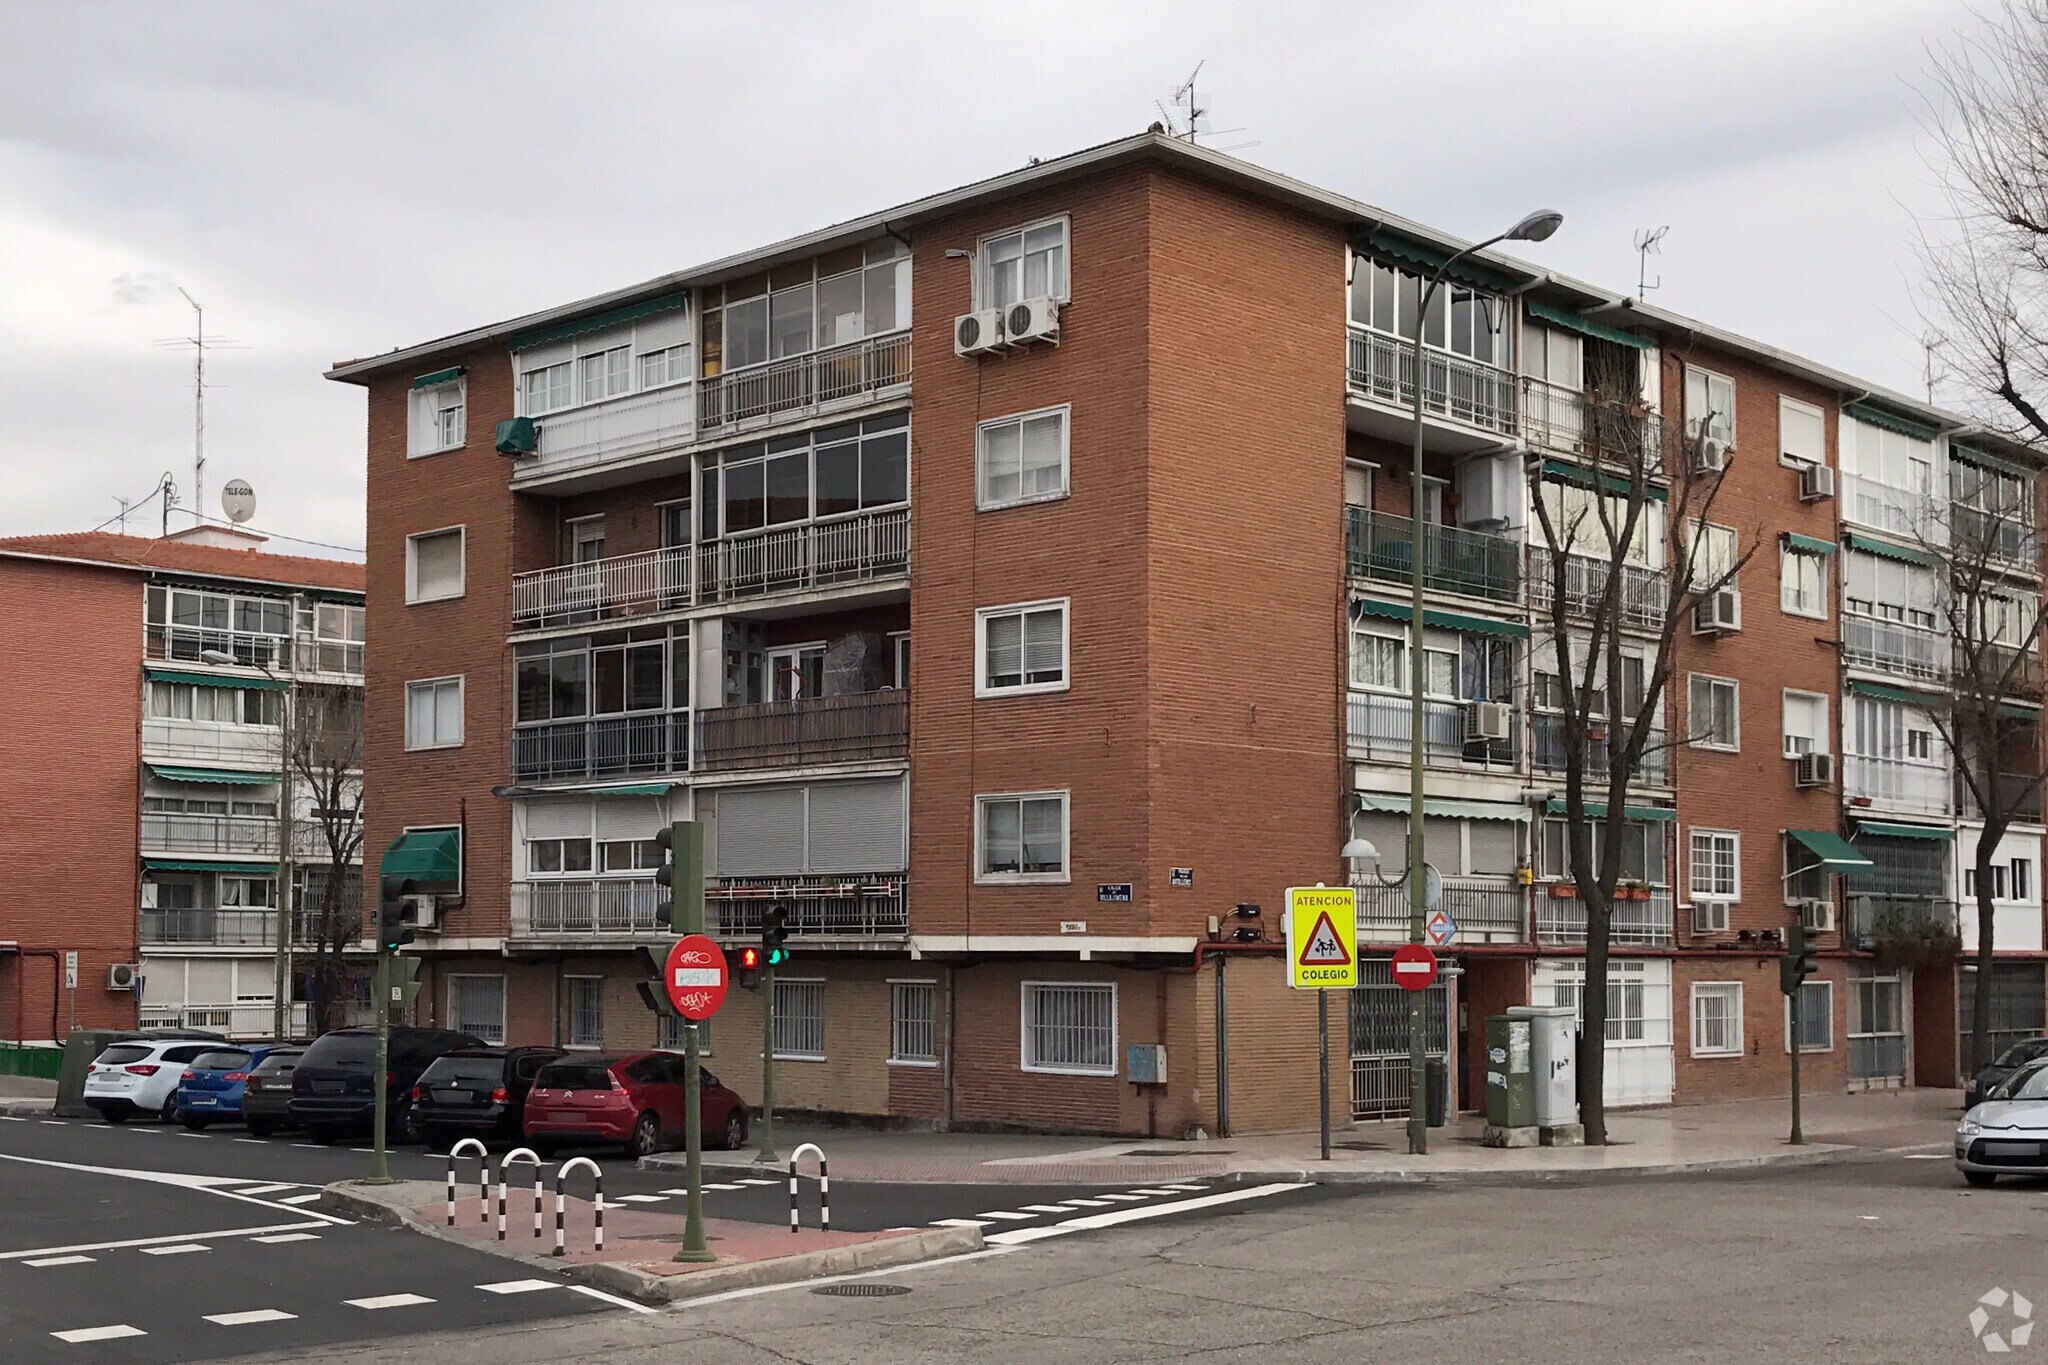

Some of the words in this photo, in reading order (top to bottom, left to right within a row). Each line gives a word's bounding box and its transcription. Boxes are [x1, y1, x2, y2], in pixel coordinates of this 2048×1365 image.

[225, 487, 253, 496] TELE-GON
[1296, 896, 1352, 906] ATENCION
[1301, 970, 1349, 980] COLEGIO
